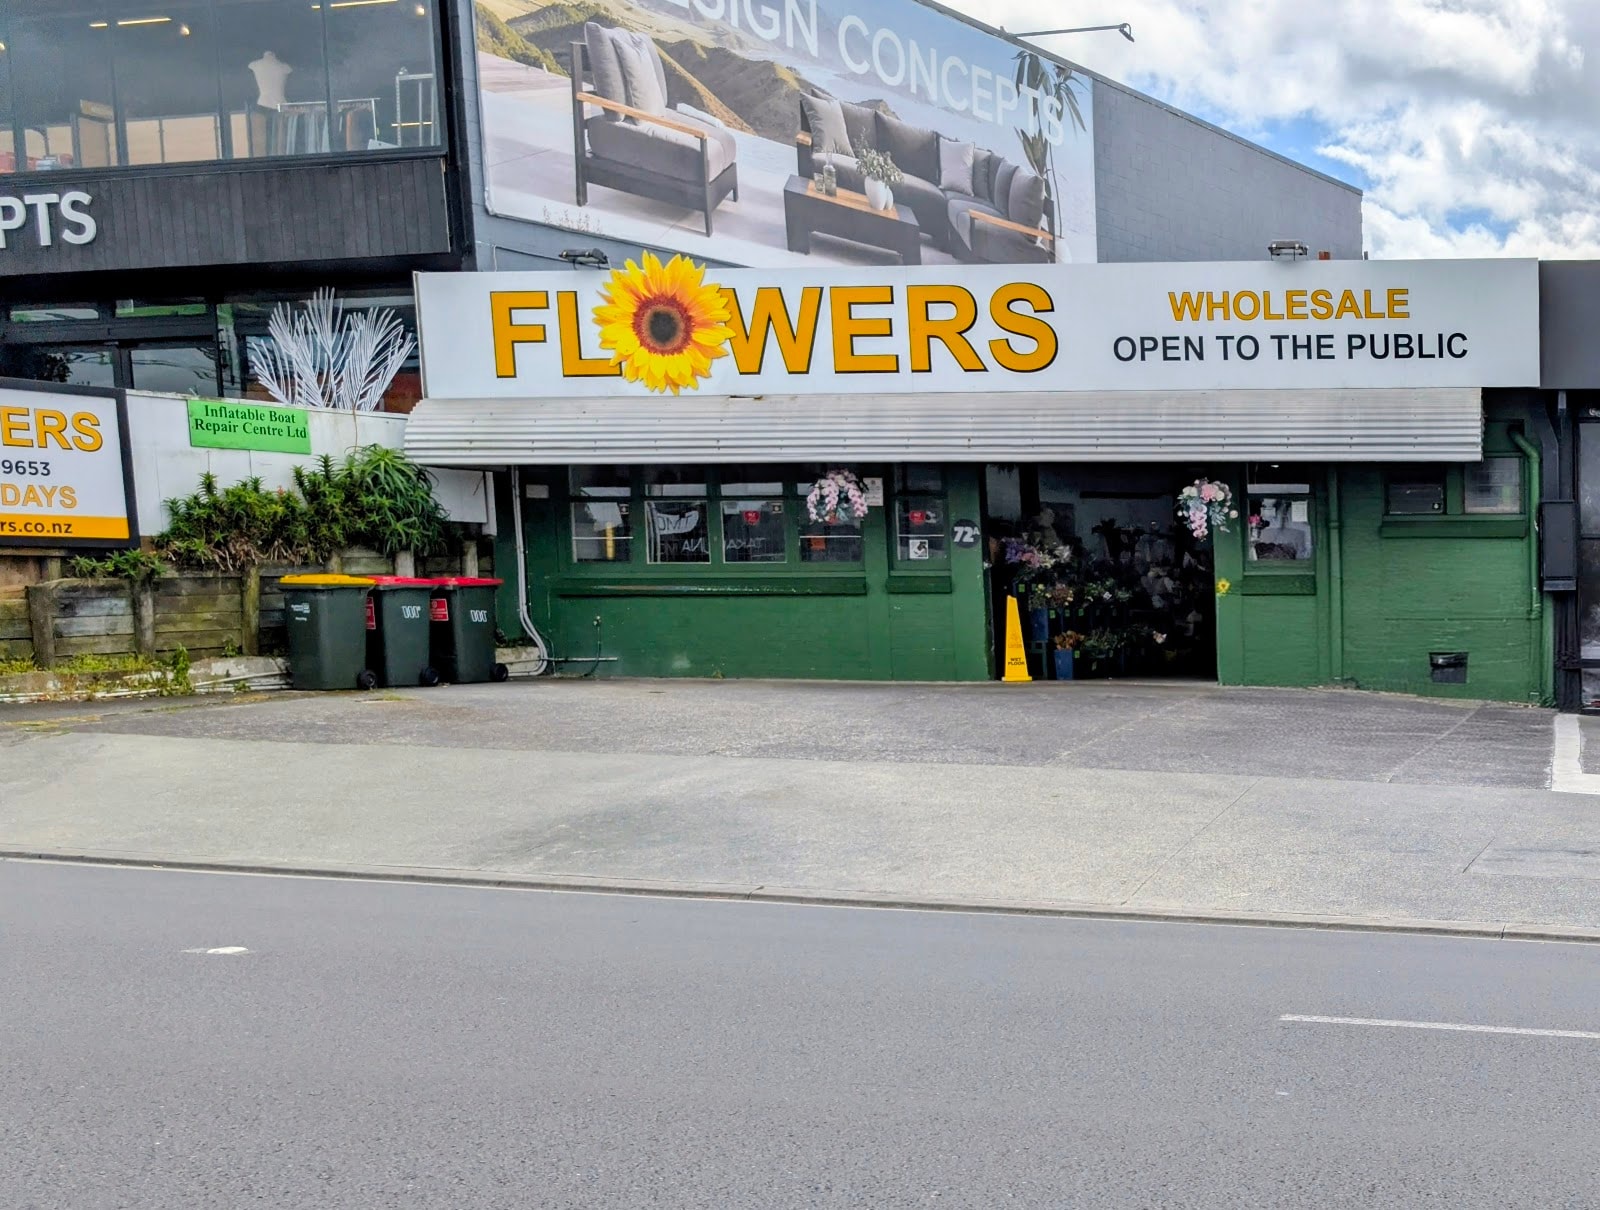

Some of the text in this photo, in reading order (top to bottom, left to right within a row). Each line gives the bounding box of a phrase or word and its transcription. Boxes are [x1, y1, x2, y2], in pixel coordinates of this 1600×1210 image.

[659, 0, 1066, 147] IGN CONCEPTS
[0, 191, 97, 249] PTS
[1167, 288, 1411, 321] WHOLESALE
[490, 281, 1060, 379] FLWERS
[1113, 332, 1469, 362] OPEN TO THE PUBLIC
[204, 404, 296, 424] Inflatable Boat
[0, 405, 104, 453] ERS
[194, 418, 307, 439] Repair Centre Ltd
[1, 459, 51, 477] 9653
[0, 483, 78, 509] DAYS
[0, 520, 73, 534] rs.co.nz
[953, 526, 981, 543] 72A
